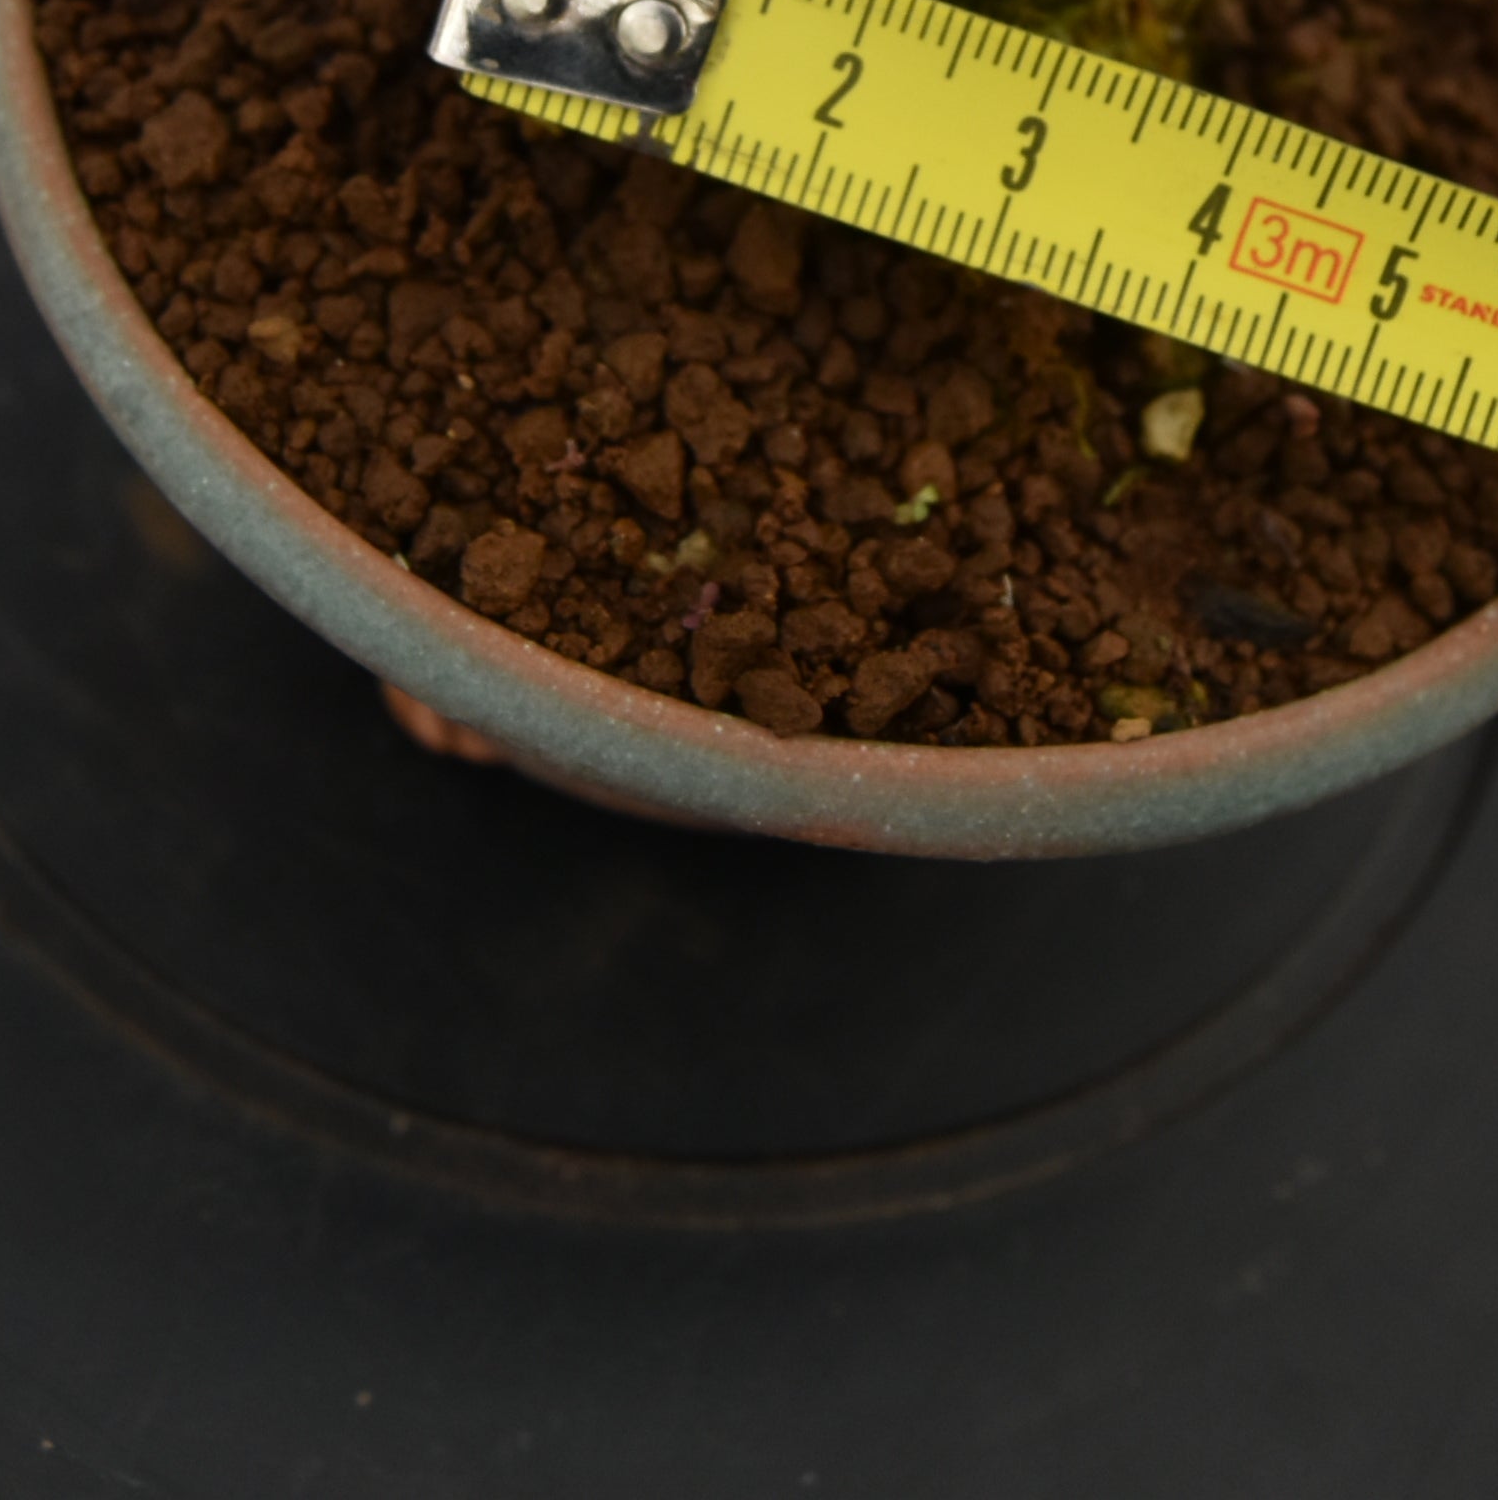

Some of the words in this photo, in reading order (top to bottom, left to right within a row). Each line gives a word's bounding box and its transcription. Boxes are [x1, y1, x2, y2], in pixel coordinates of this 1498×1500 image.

[813, 52, 864, 129] 2
[1000, 116, 1048, 192] 3
[1187, 182, 1232, 256] 4
[1249, 214, 1344, 290] 3m
[1369, 244, 1420, 321] 5
